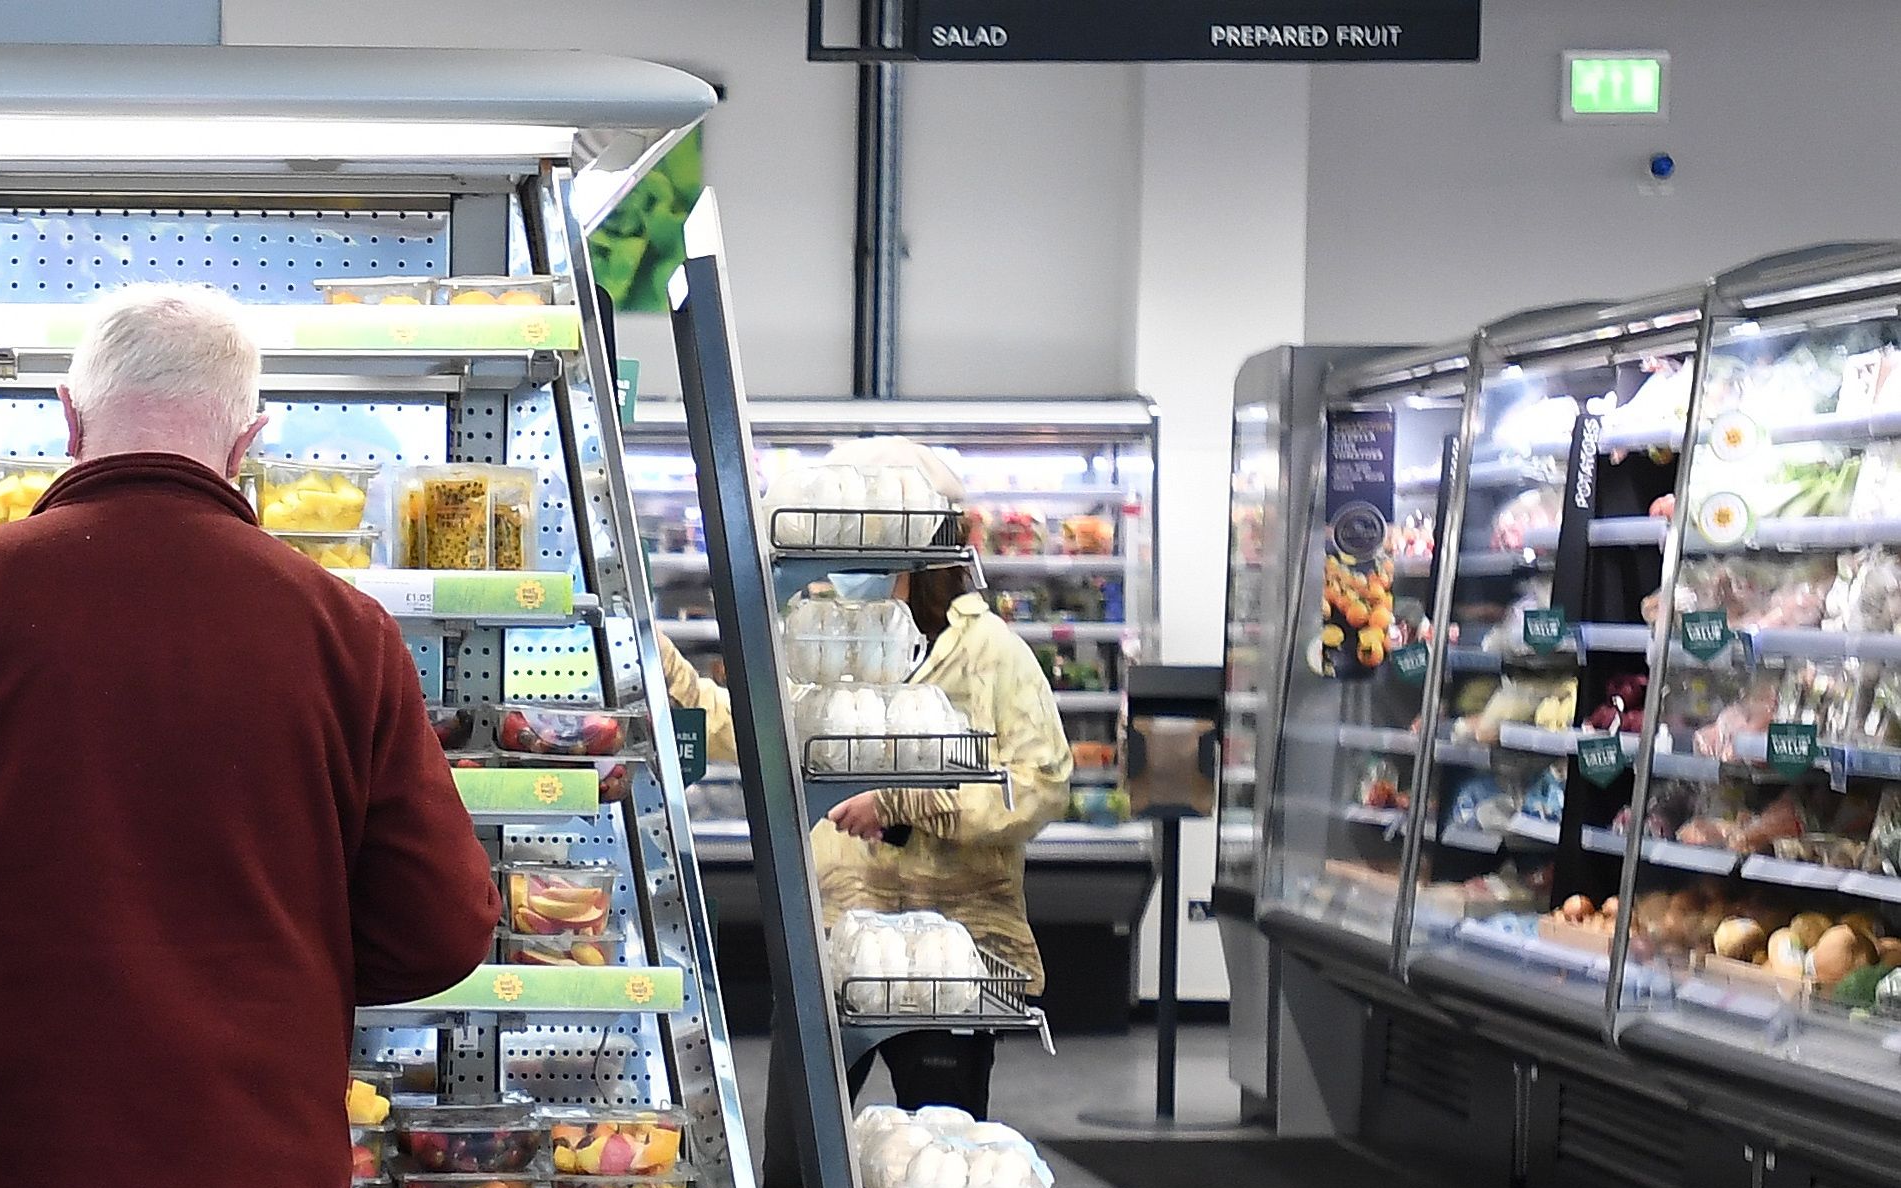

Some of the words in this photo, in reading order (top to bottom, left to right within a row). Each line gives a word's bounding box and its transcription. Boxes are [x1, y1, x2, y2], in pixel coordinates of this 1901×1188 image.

[931, 25, 1009, 48] SALAD
[1210, 25, 1330, 48] PREPARED
[1336, 25, 1403, 48] FRUIT
